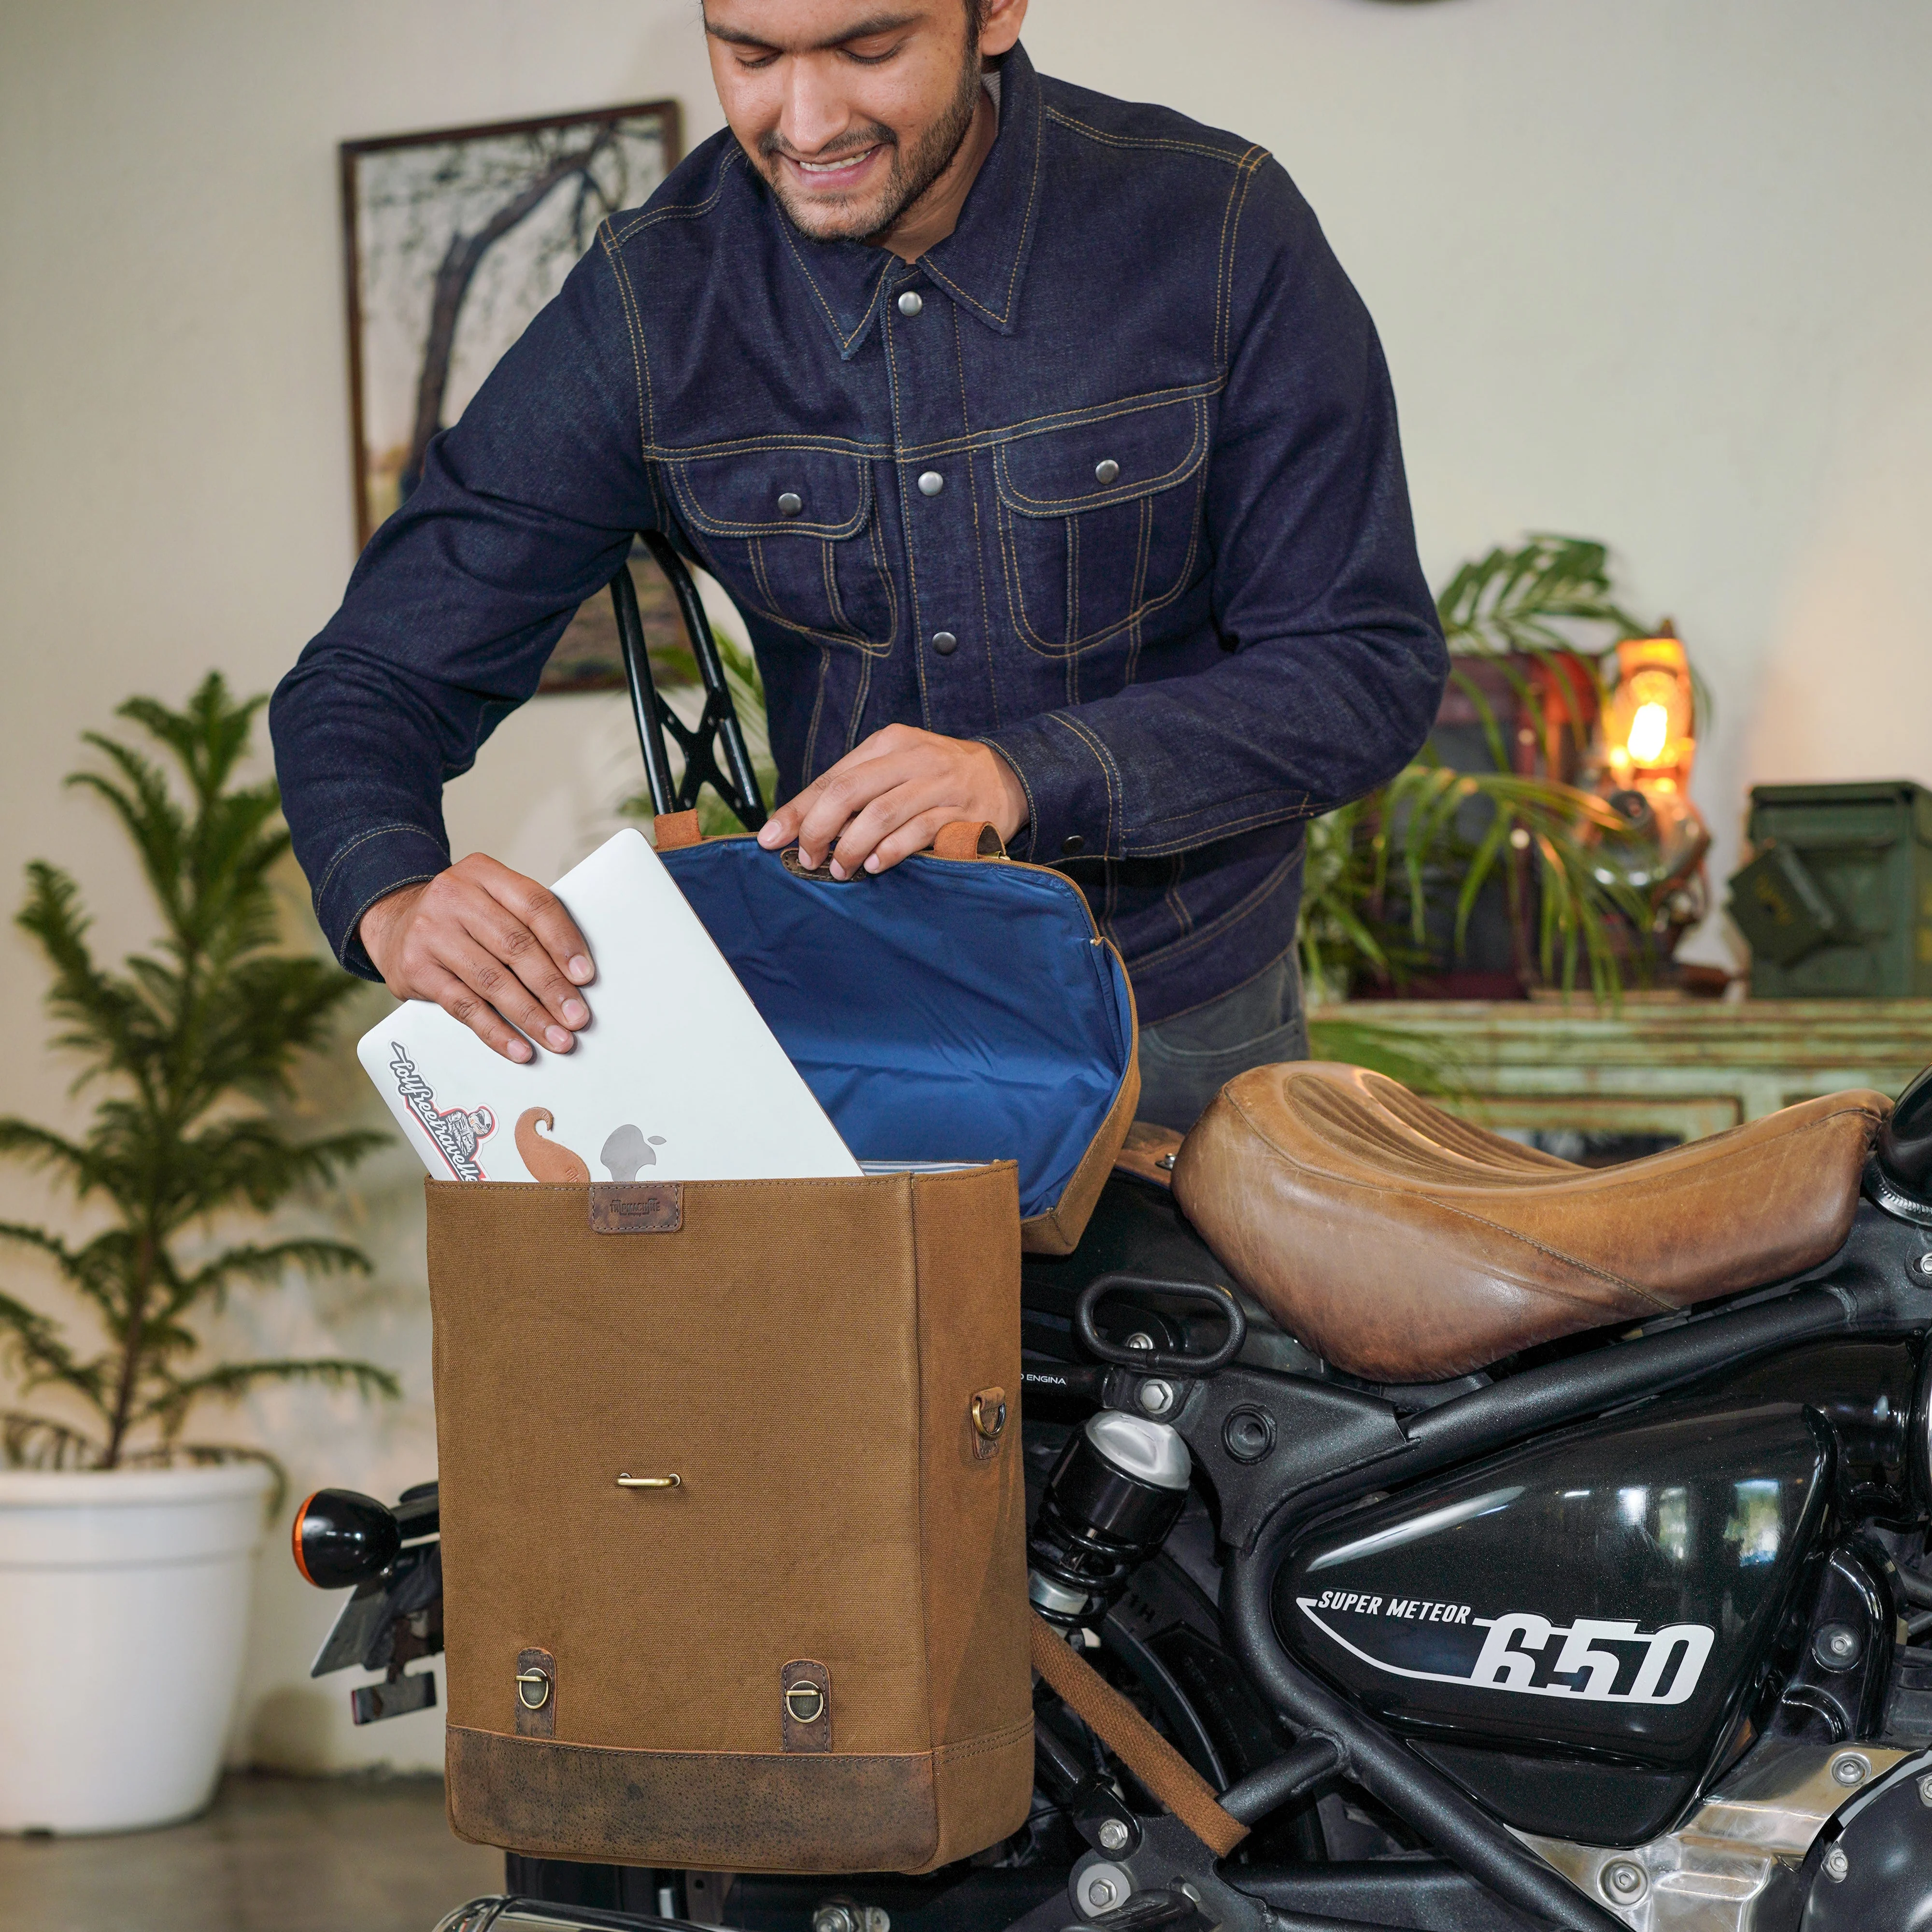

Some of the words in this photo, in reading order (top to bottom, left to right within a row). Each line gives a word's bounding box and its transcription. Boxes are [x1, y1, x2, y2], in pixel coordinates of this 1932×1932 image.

[1026, 1374, 1066, 1385] ENGINA
[1318, 1591, 1382, 1615] SUPER
[1386, 1598, 1471, 1624] METEOR
[1470, 1612, 1716, 1705] 650
